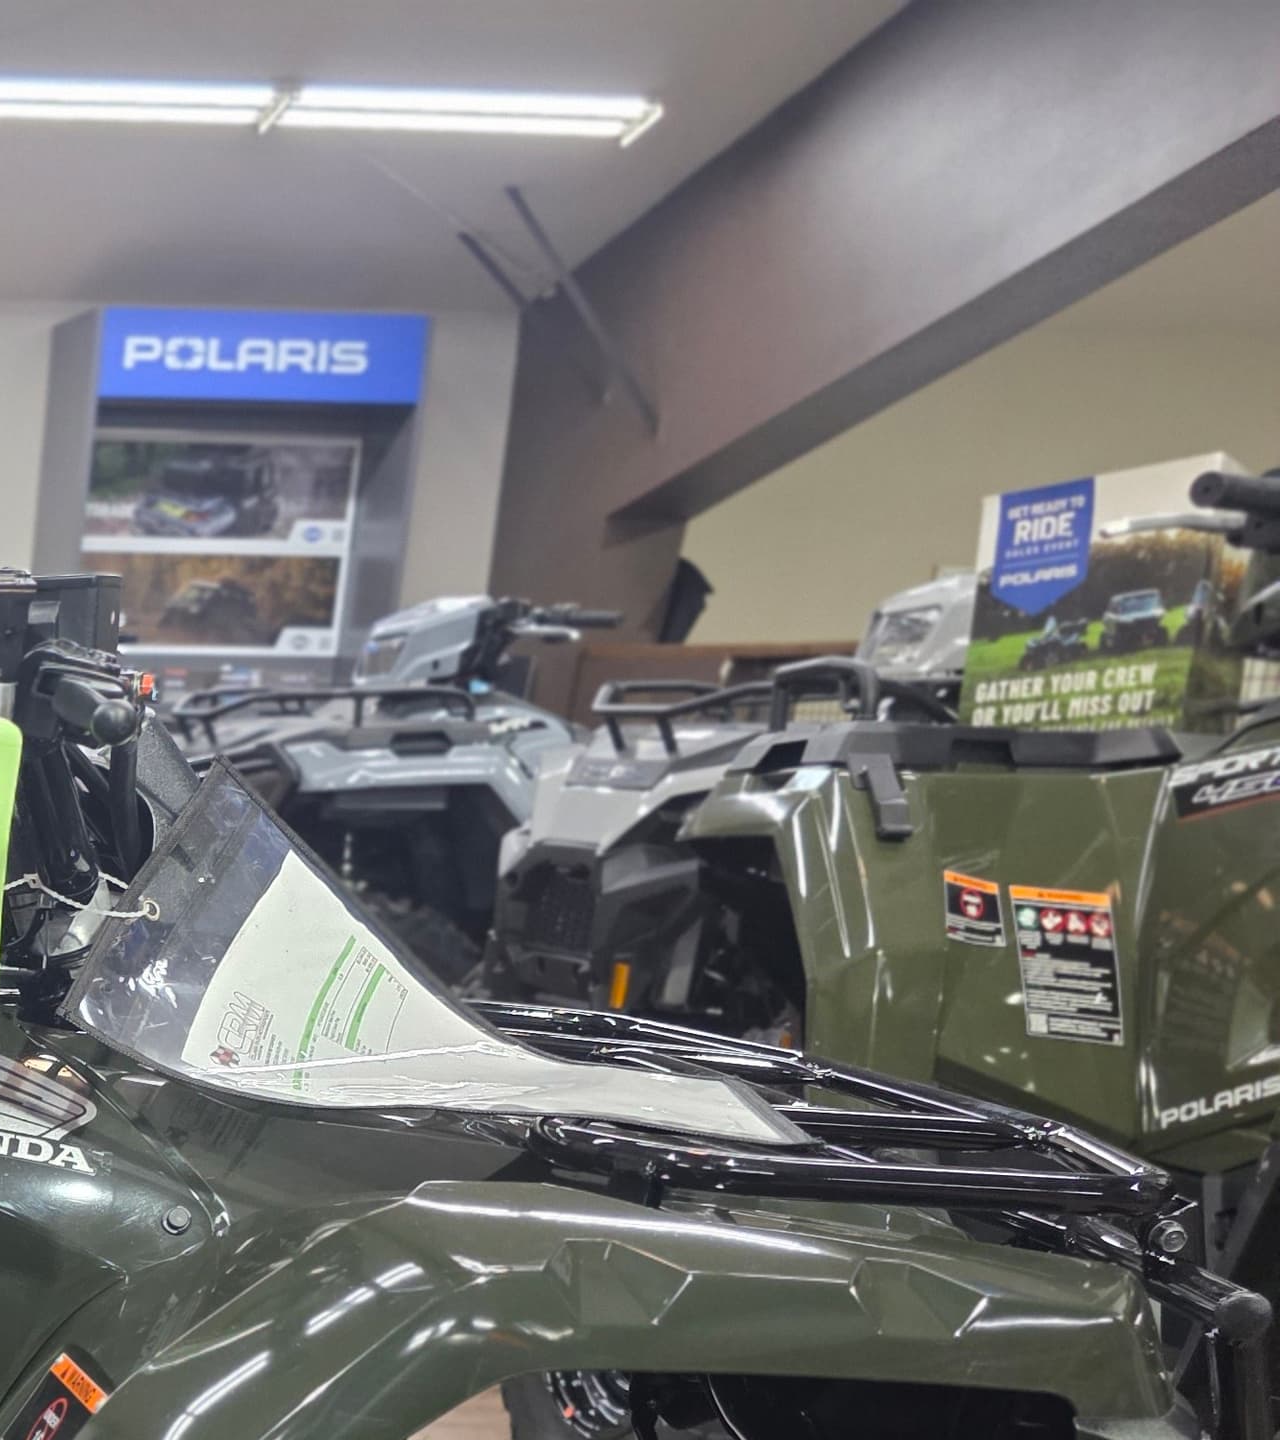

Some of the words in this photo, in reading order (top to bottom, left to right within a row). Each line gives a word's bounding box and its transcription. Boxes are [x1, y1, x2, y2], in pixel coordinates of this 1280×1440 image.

[123, 335, 368, 374] POLARIS
[1013, 511, 1075, 545] RIDE
[998, 563, 1078, 589] POLARIS
[974, 676, 1044, 703] GATHER
[1051, 670, 1097, 694] YOUR
[1103, 662, 1158, 689] CREW
[971, 706, 996, 727] OR
[1068, 694, 1111, 719] MISS
[1118, 689, 1155, 713] OUT
[1160, 1075, 1280, 1130] POLARIS
